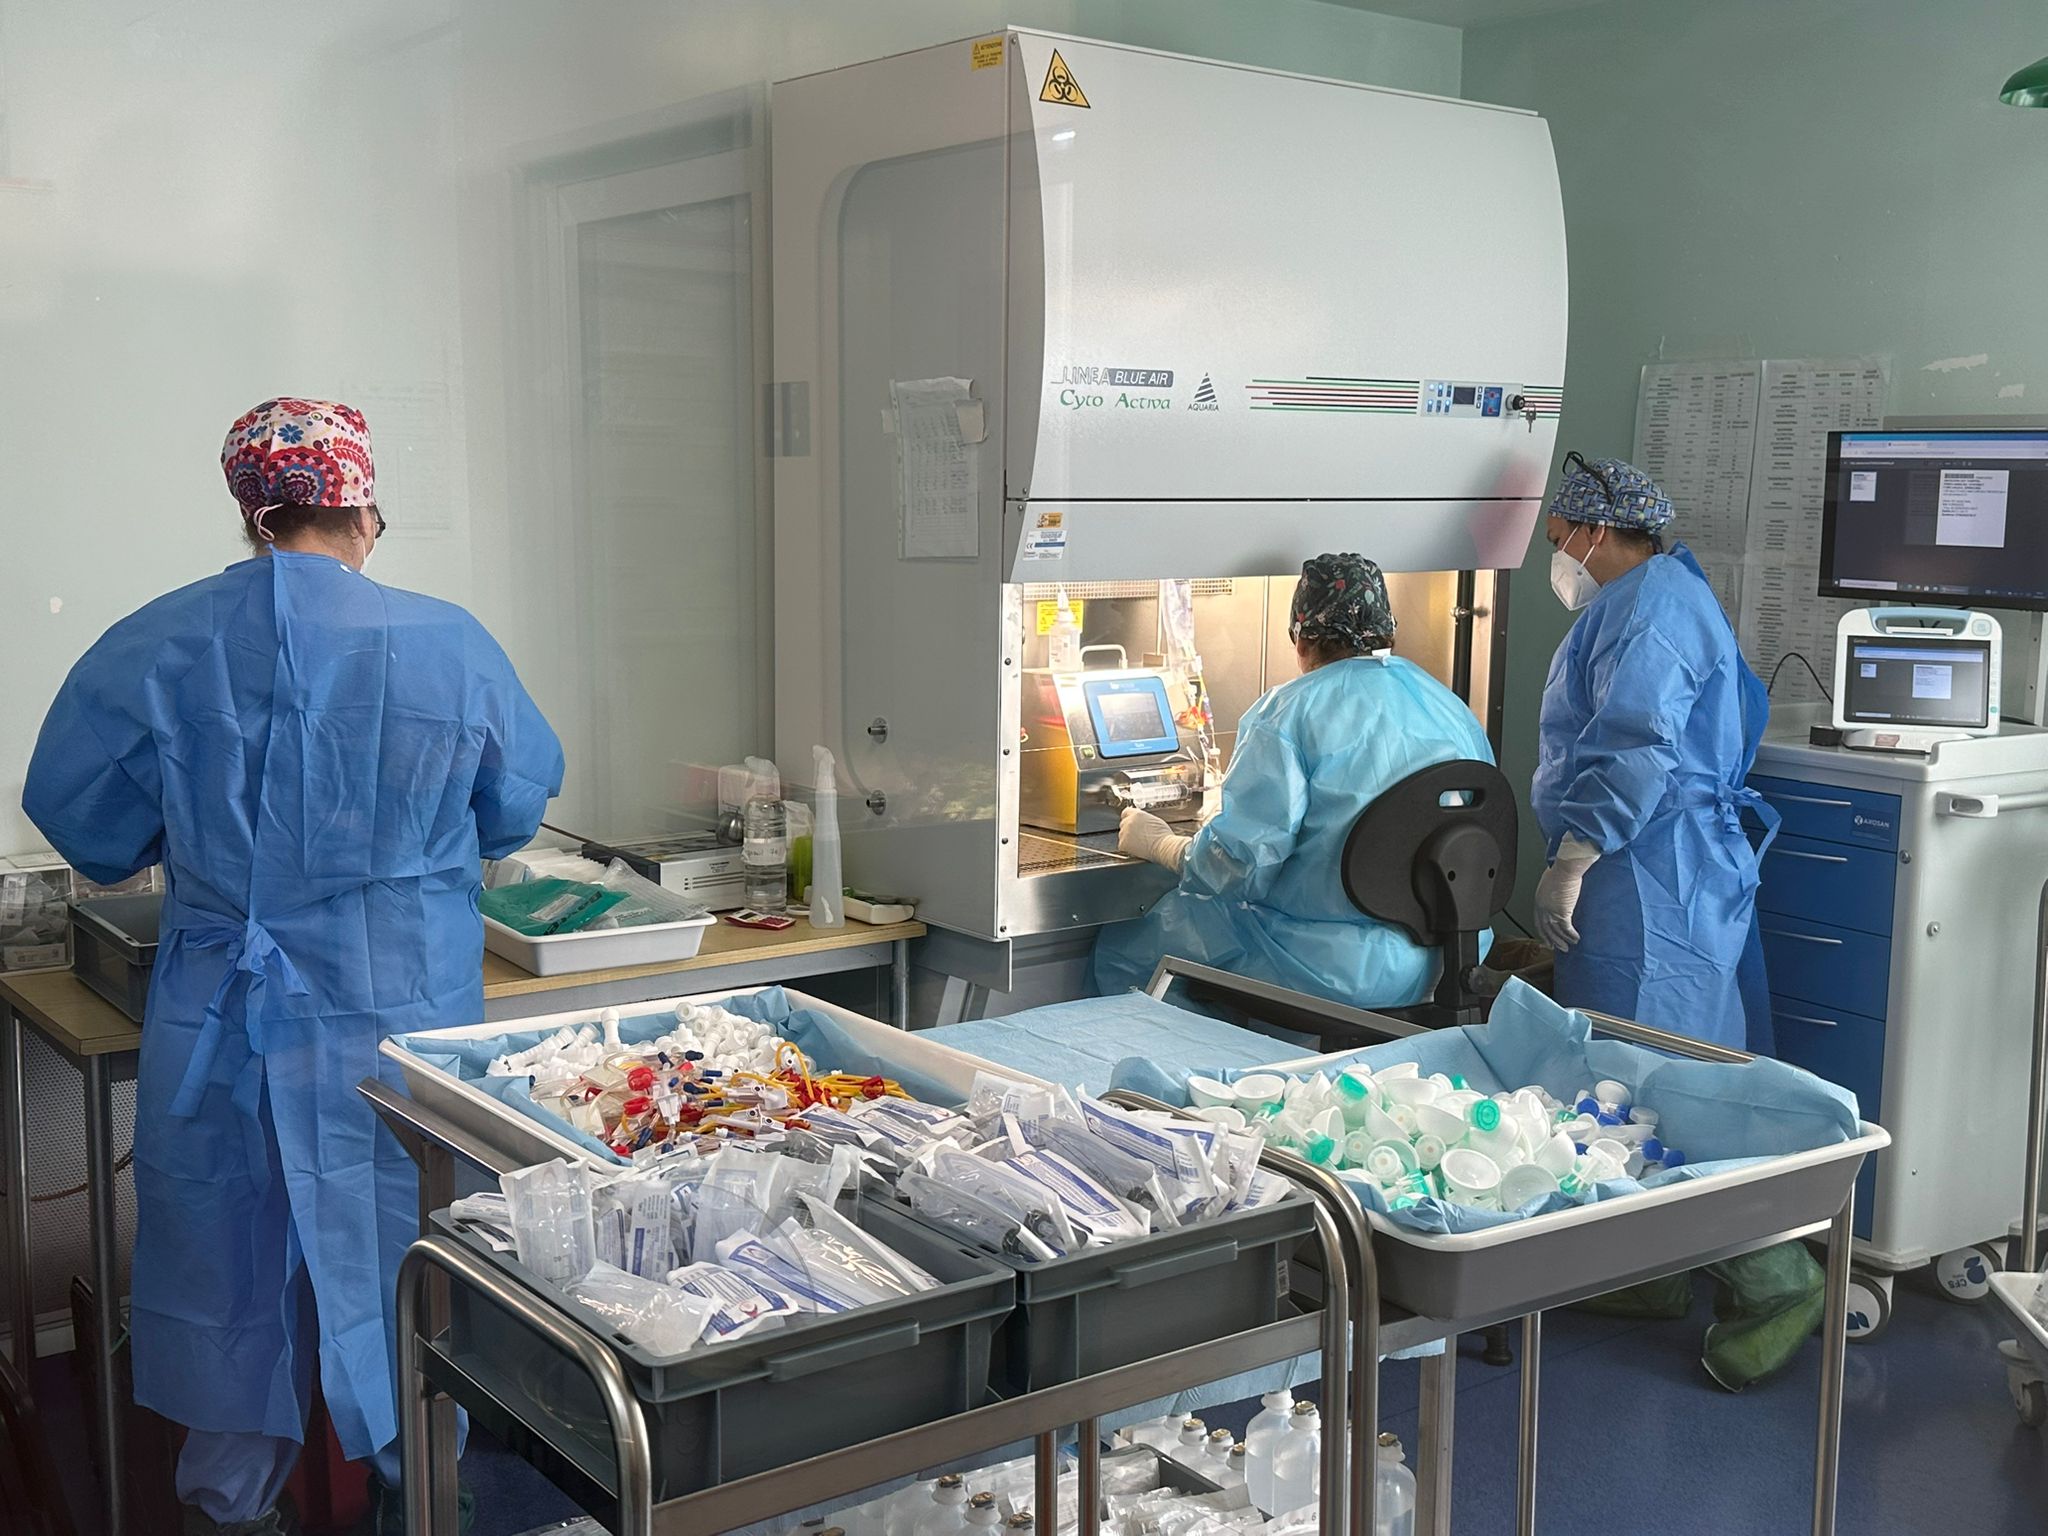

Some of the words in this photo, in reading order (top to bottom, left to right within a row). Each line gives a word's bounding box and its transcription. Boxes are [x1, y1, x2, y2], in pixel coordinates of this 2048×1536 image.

[1061, 366, 1109, 386] LINEA
[1115, 371, 1148, 385] BLUE
[1148, 373, 1168, 385] AIR
[1060, 389, 1104, 411] Cyto
[1115, 392, 1171, 410] Activa
[1187, 403, 1219, 412] AQUARIA
